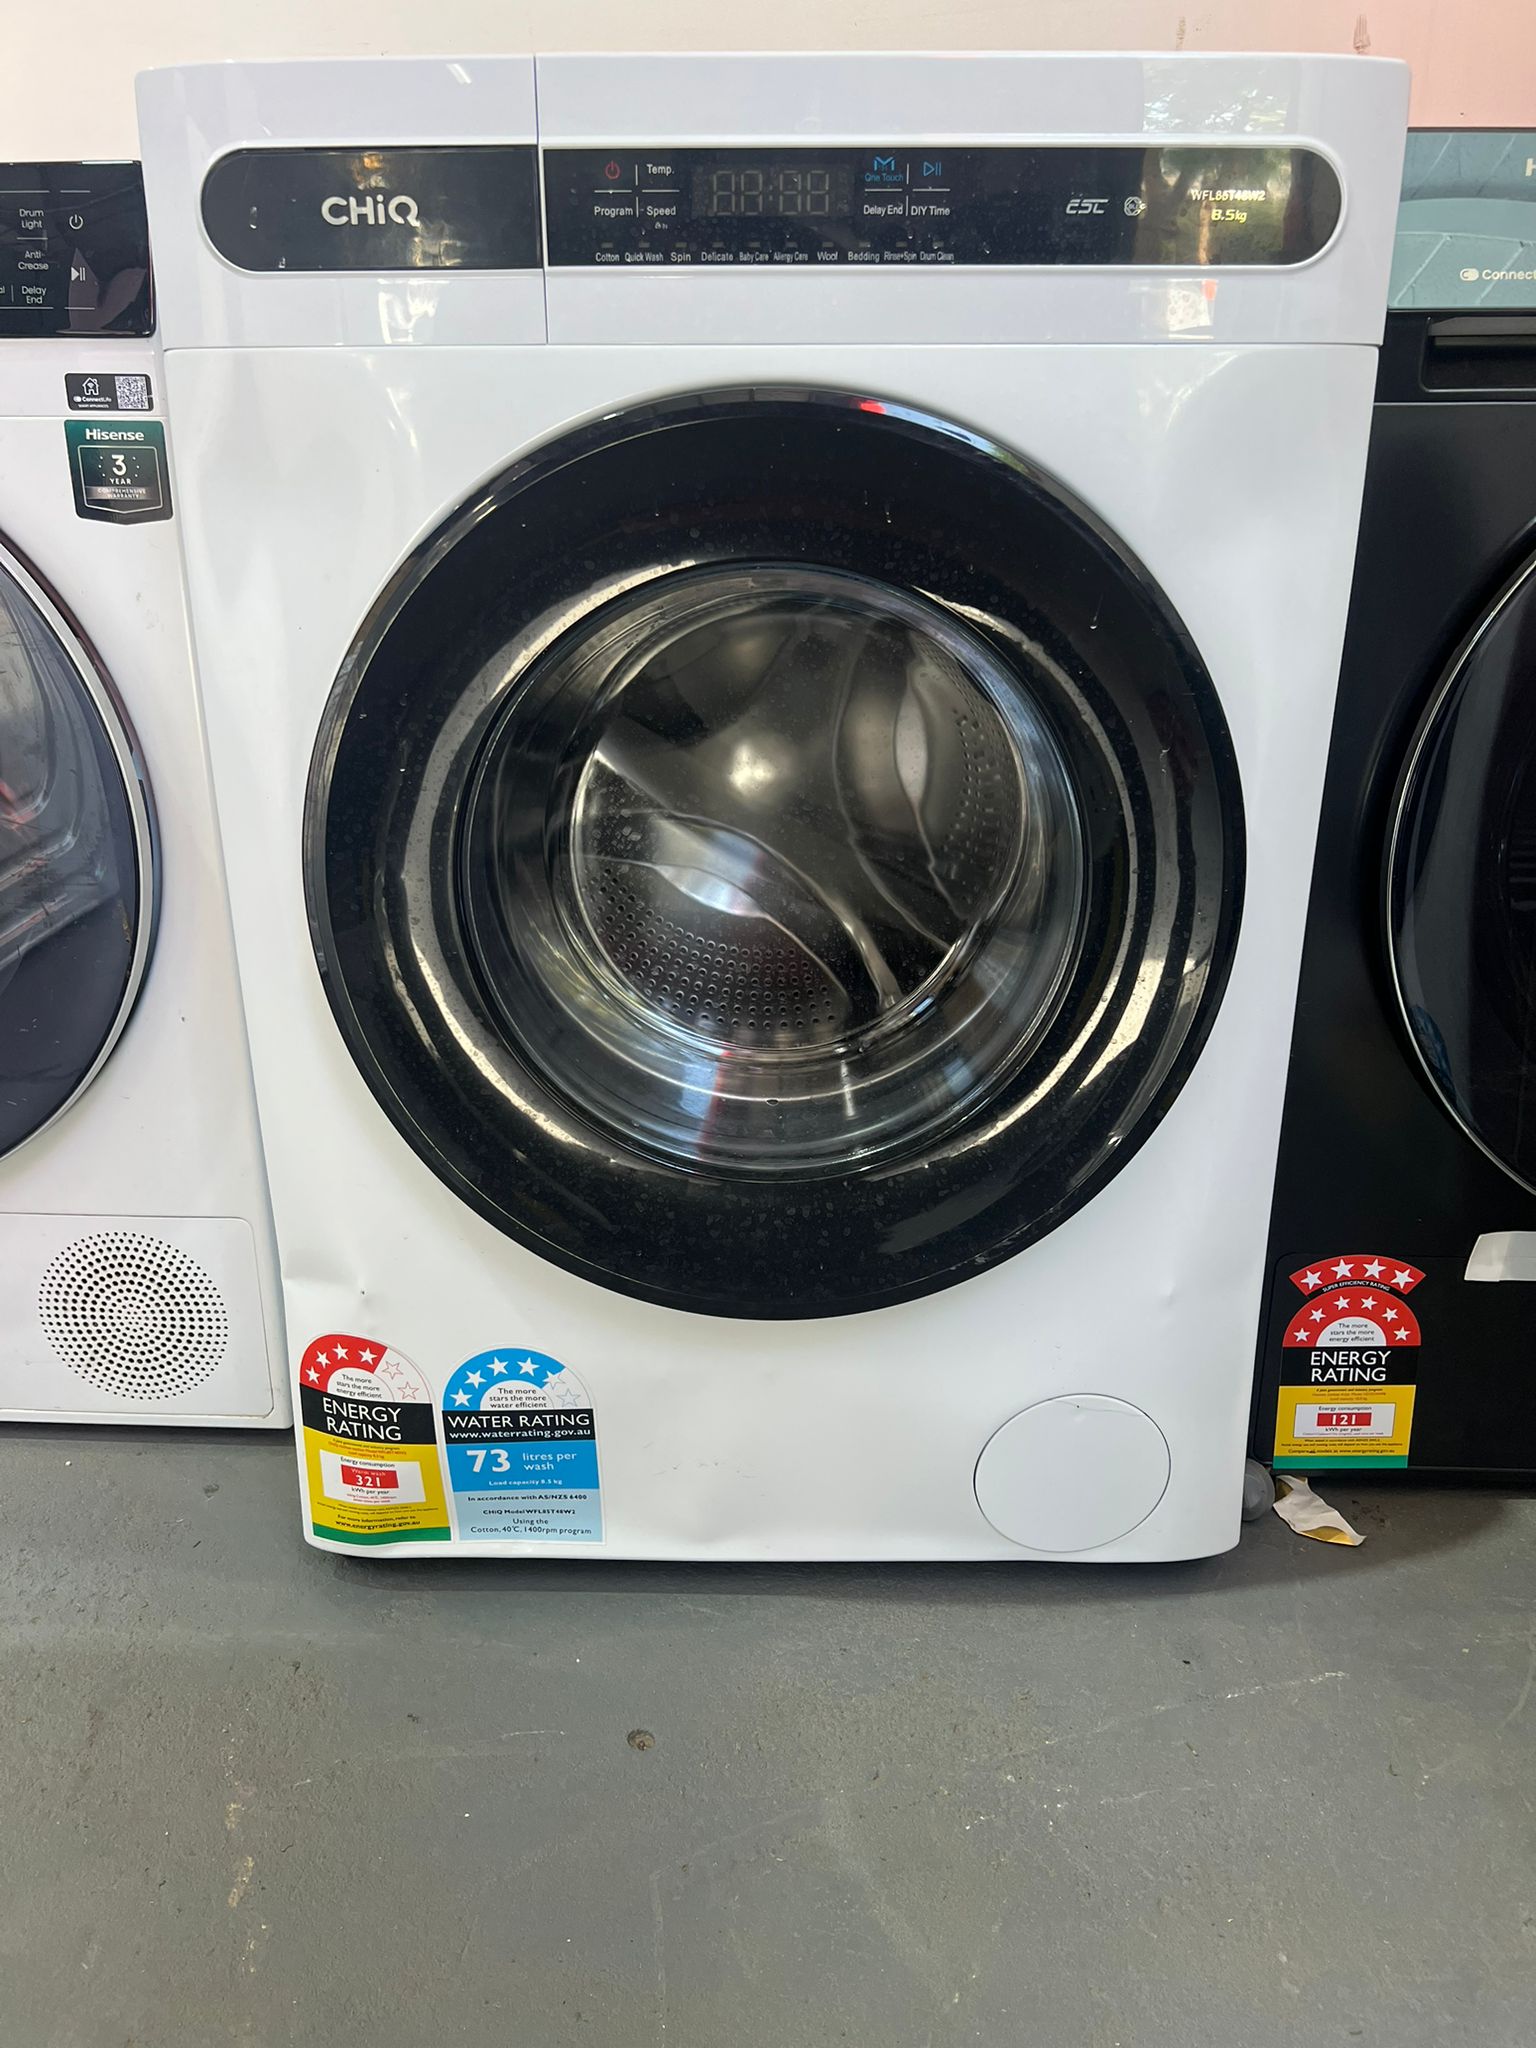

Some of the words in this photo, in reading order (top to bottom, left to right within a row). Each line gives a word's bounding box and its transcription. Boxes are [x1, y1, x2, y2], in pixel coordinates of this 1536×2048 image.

[646, 164, 675, 175] Temp.
[865, 173, 881, 182] One
[882, 173, 904, 182] Touch
[19, 209, 44, 217] Drum
[321, 194, 421, 226] CHiQ
[594, 206, 634, 218] Program
[646, 205, 676, 217] Speed
[863, 204, 887, 217] Delay
[888, 205, 903, 215] End
[911, 206, 927, 216] DIY
[929, 206, 950, 216] Time
[1211, 208, 1248, 224] 8.5kg
[21, 220, 42, 230] Light
[24, 251, 45, 259] Anti-
[595, 252, 620, 263] Cotton
[624, 252, 644, 263] Quick
[645, 252, 664, 262] Wash
[670, 252, 692, 265] Spin
[701, 252, 733, 262] Delicate
[739, 252, 754, 264] Baby
[755, 252, 769, 262] Care
[817, 252, 838, 261] Wool
[847, 252, 880, 263] Bedding
[920, 252, 936, 261] Drum
[936, 252, 954, 261] Clean
[17, 261, 49, 270] Crease
[21, 285, 47, 295] Delay
[26, 295, 43, 304] End
[85, 428, 145, 442] Hisense
[111, 454, 127, 476] 3
[1322, 1283, 1339, 1292] SUPER
[1370, 1281, 1390, 1291] RATING
[1310, 1350, 1392, 1366] ENERGY
[342, 1374, 354, 1382] The
[1311, 1367, 1387, 1382] RATING
[336, 1388, 357, 1397] energy
[497, 1387, 514, 1395] The
[511, 1394, 525, 1402] the
[515, 1400, 547, 1408] efficient
[322, 1397, 402, 1423] ENERGY
[448, 1414, 514, 1429] WATER
[519, 1413, 590, 1428] RATING
[1331, 1414, 1357, 1425] 121
[326, 1416, 402, 1441] RATING
[449, 1428, 591, 1440] www.waterrating.gov.au
[340, 1456, 358, 1466] Energy
[466, 1449, 511, 1474] 73
[522, 1452, 554, 1462] litres
[556, 1453, 577, 1463] per
[524, 1461, 555, 1471] wash
[355, 1474, 382, 1487] 321
[476, 1494, 520, 1502] accordance
[335, 1520, 421, 1530] www.energyrating.gov.au
[513, 1518, 535, 1526] Using
[524, 1527, 558, 1535] 1400rpm
